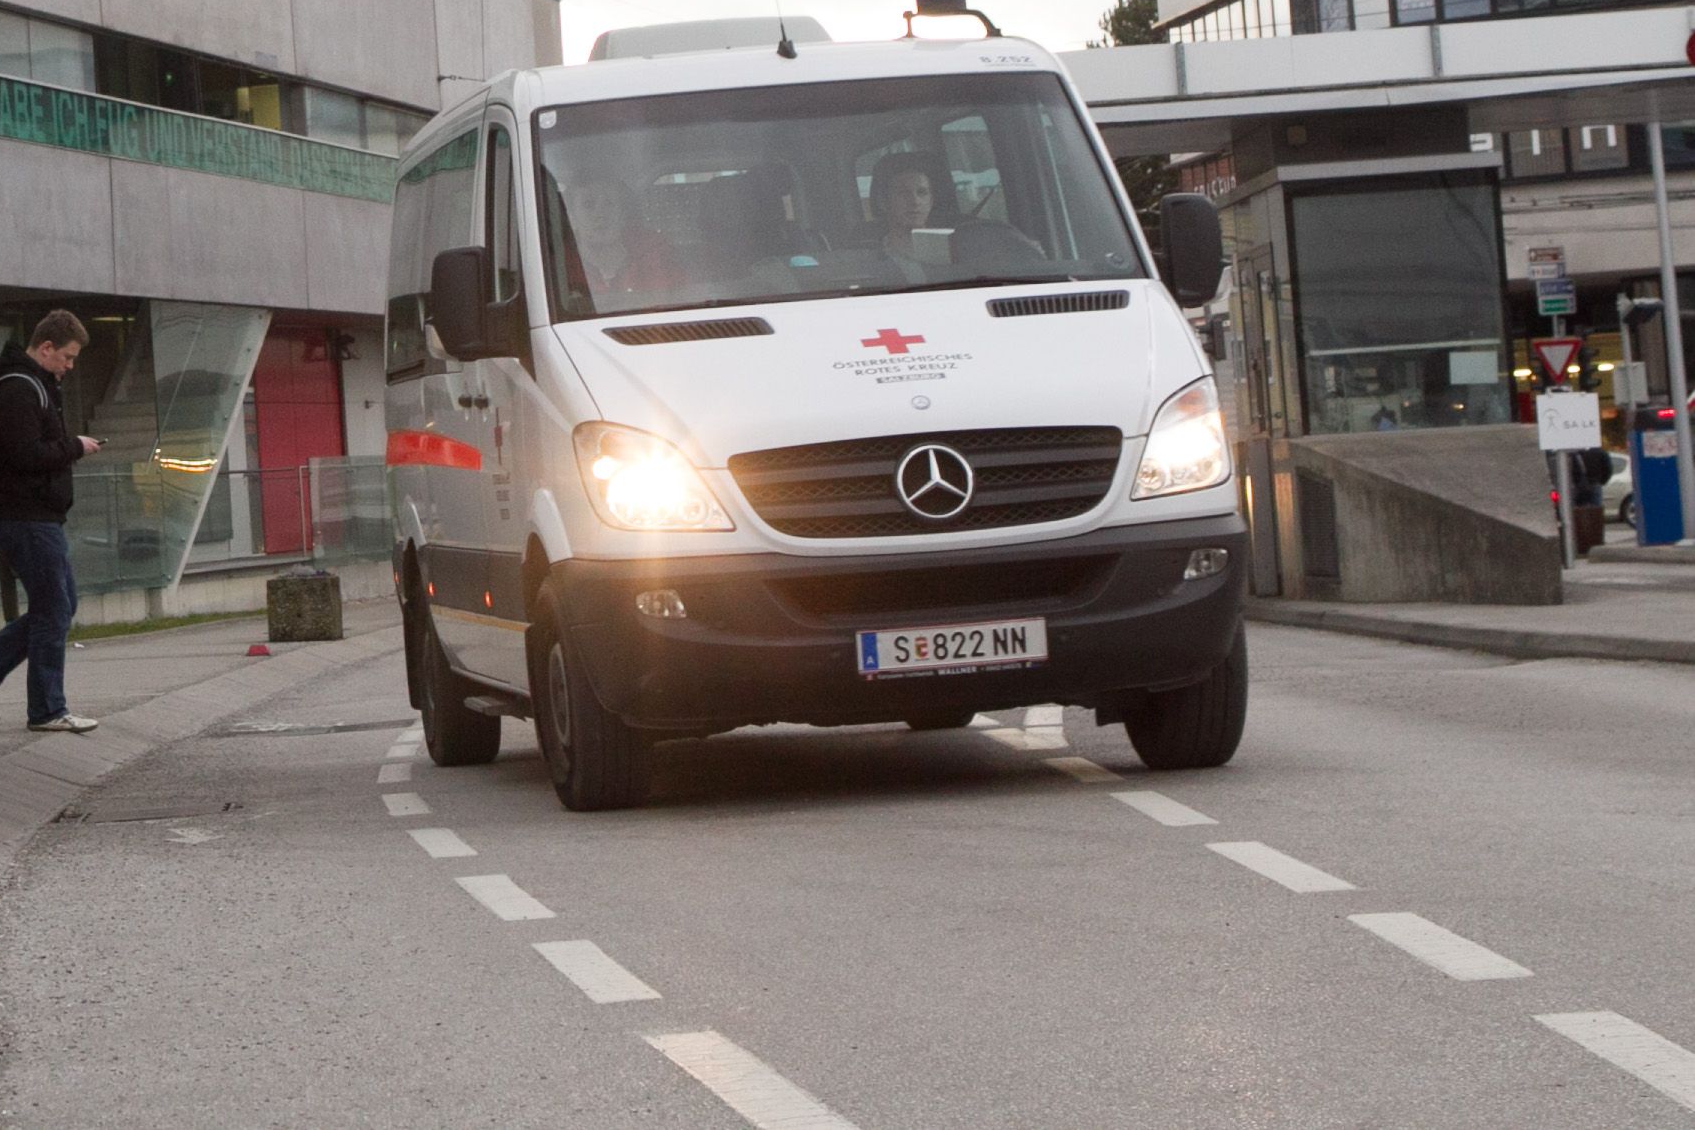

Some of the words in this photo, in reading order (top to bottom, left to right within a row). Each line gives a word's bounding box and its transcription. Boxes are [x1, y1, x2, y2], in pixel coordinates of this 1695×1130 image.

[53, 89, 91, 153] ICH
[95, 99, 141, 160] FUG
[144, 109, 187, 167] UND
[833, 353, 973, 370] ÖSTERREICHISCHES
[855, 365, 901, 376] ROTES
[907, 362, 958, 372] KREUZ
[893, 635, 911, 664] S
[932, 629, 986, 661] 822
[992, 626, 1028, 657] NN
[866, 656, 875, 665] A
